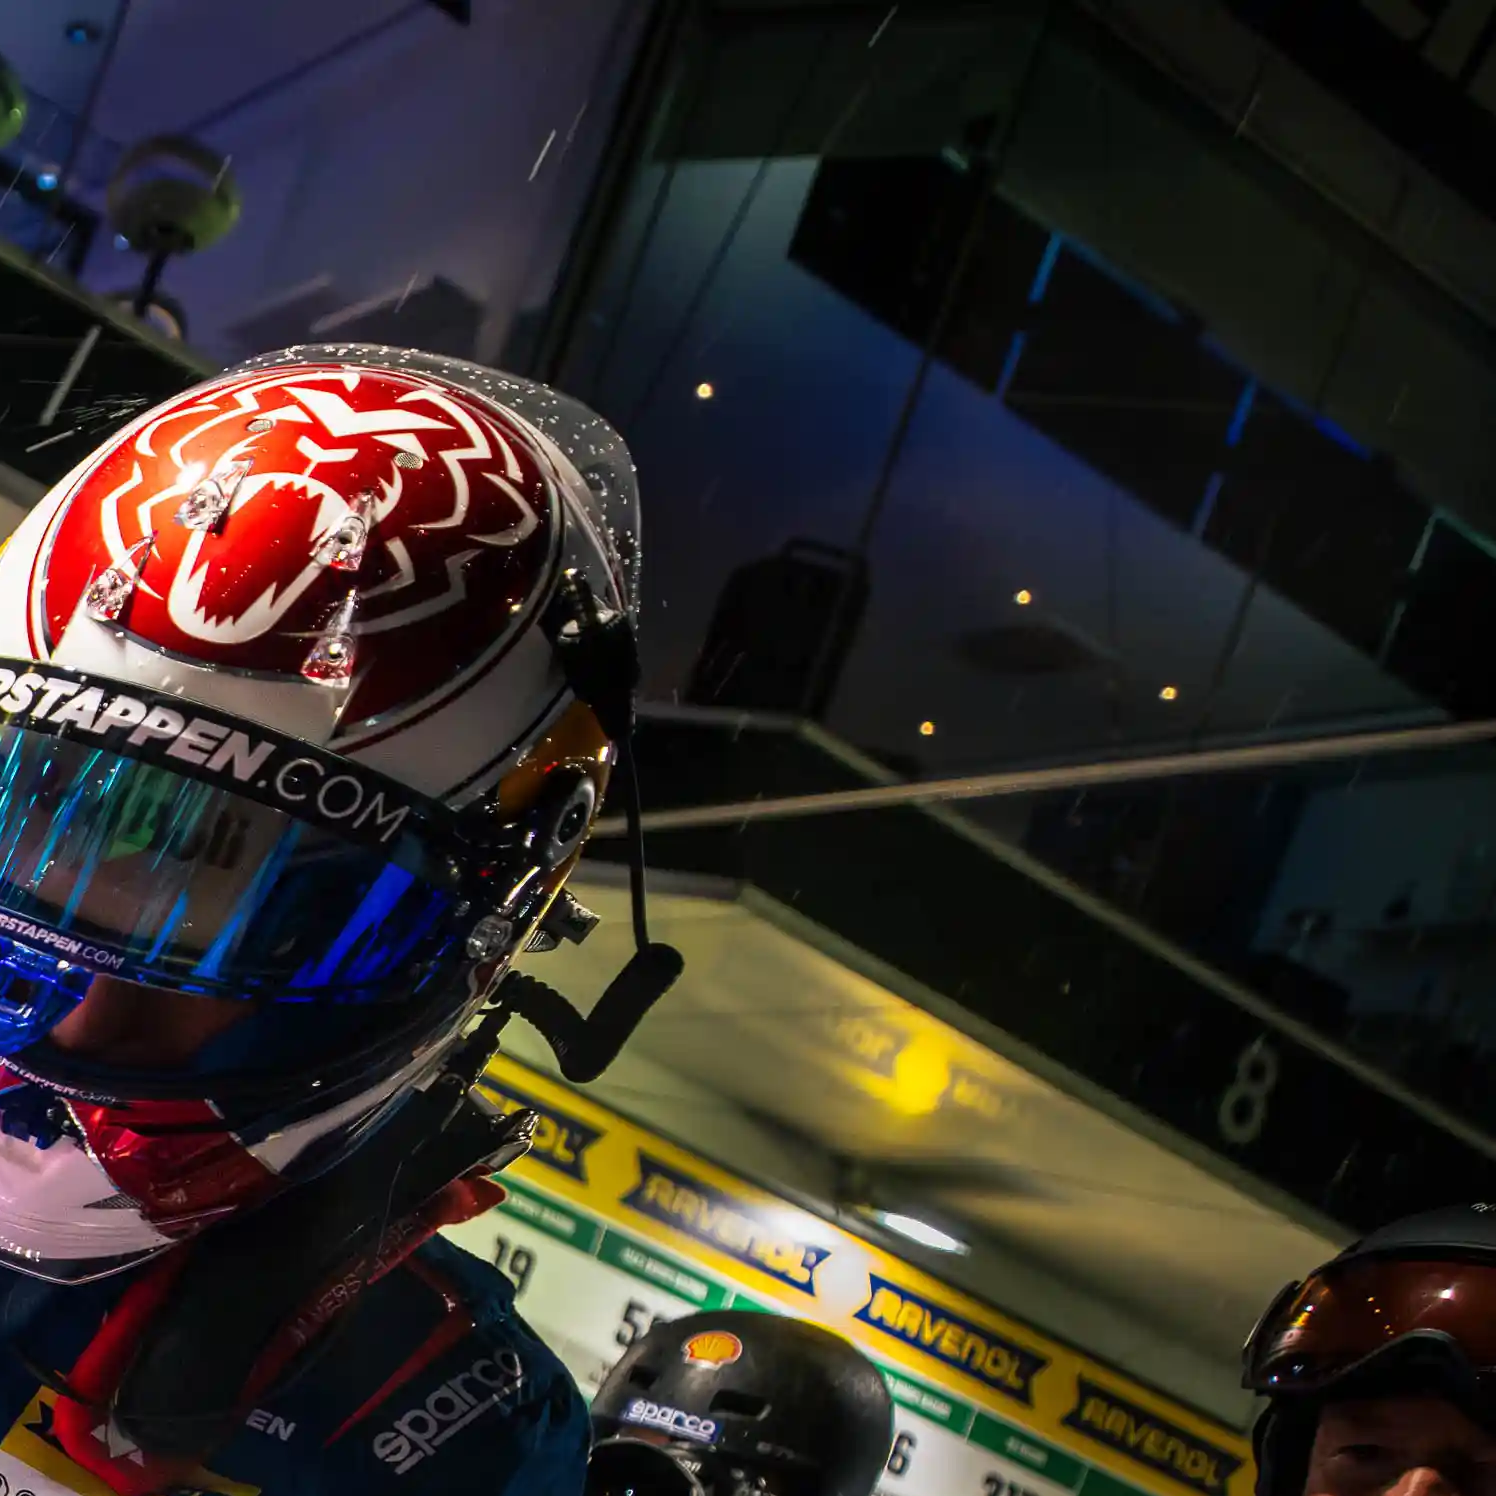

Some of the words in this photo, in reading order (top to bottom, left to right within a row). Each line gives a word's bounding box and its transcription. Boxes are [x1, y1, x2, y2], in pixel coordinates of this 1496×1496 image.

[1216, 1039, 1278, 1146] 8
[645, 1172, 814, 1283] RAVENOL
[868, 1286, 1025, 1391] RAVENOL
[372, 1346, 524, 1477] sparco
[628, 1399, 717, 1437] sparco
[1078, 1393, 1223, 1488] RAVENOL
